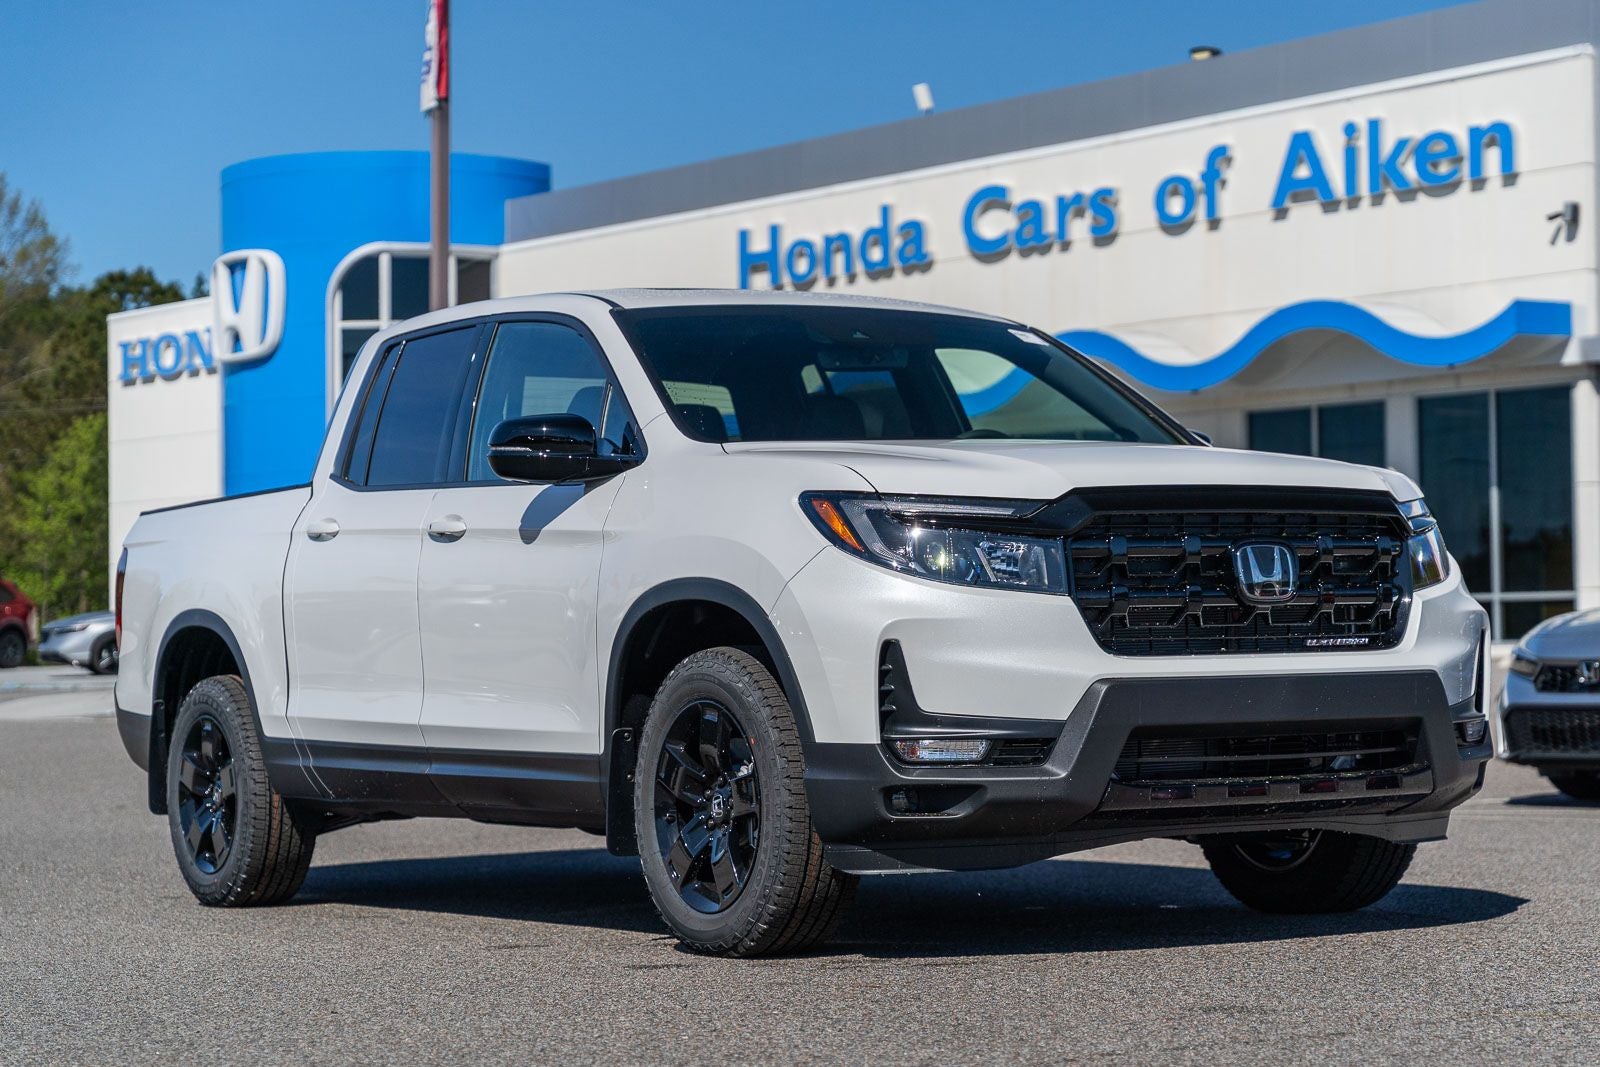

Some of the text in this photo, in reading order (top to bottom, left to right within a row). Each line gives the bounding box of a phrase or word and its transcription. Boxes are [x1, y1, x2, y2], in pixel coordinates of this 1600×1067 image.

[738, 117, 1516, 292] Honda Cars of Aiken
